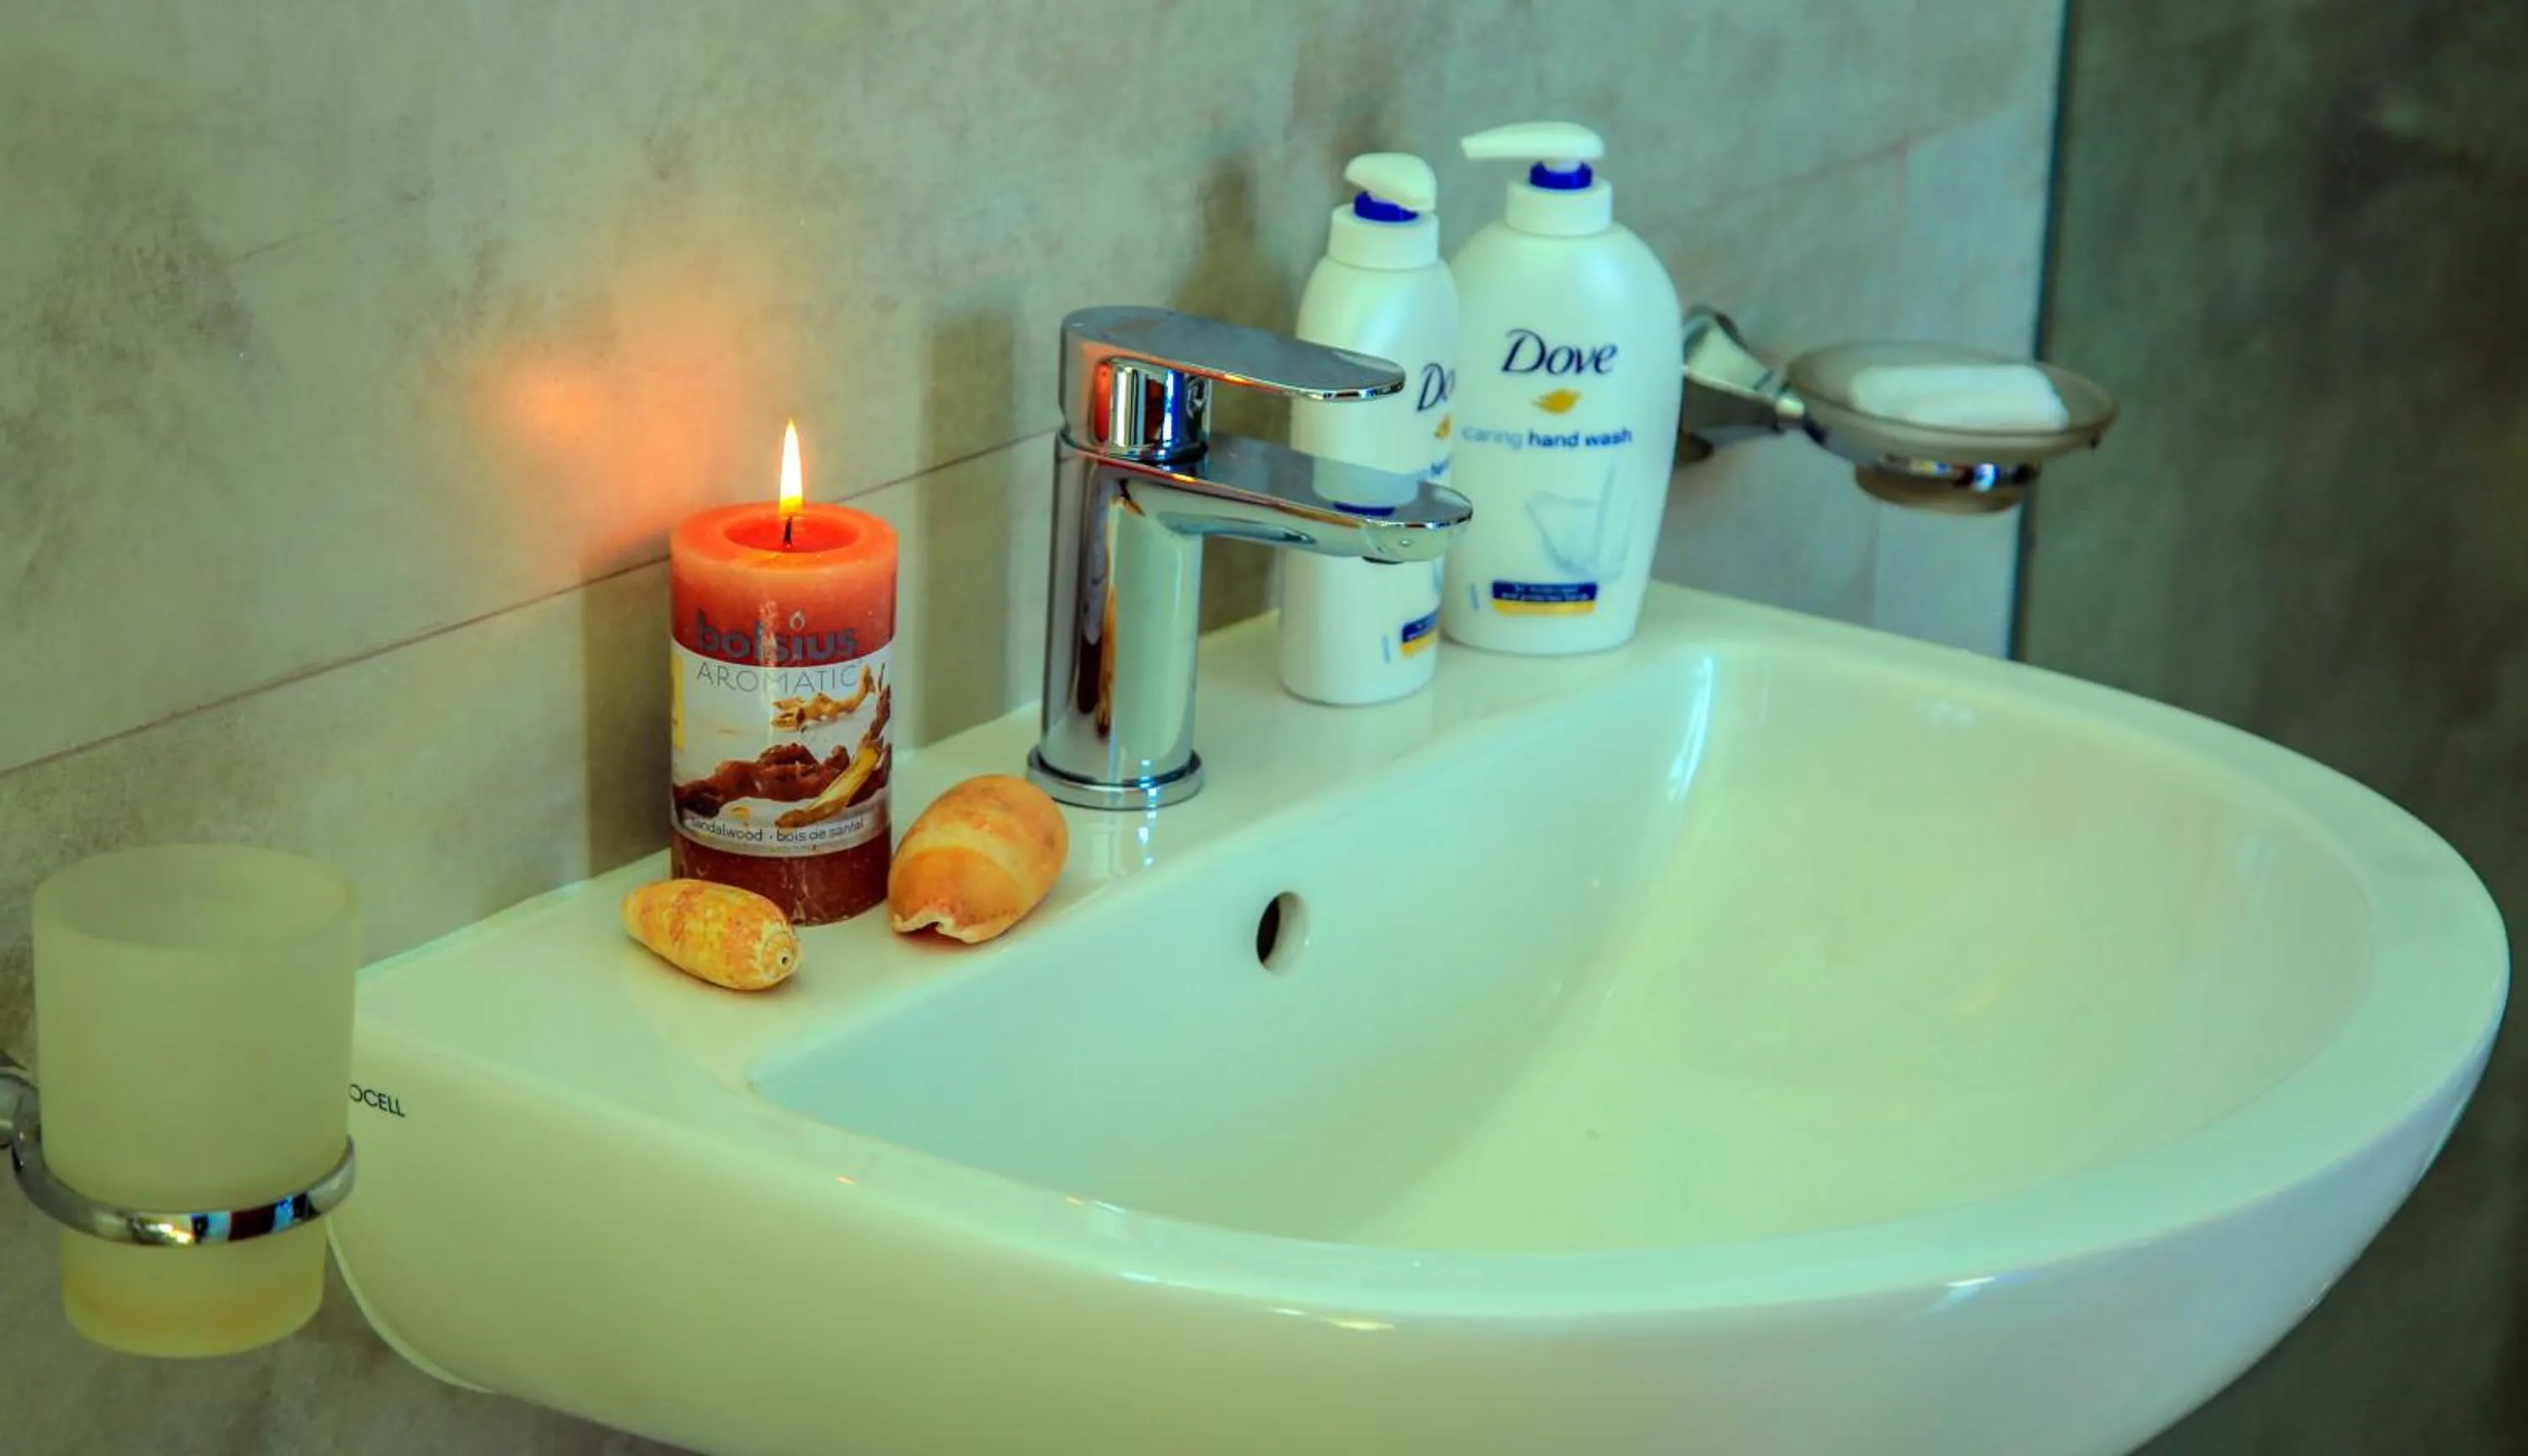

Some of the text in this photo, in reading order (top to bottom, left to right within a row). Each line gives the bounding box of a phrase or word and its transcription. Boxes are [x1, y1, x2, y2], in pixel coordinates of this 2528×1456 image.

[1500, 329, 1618, 376] Dove
[1461, 426, 1632, 450] caring hand wash
[696, 608, 857, 661] bolsius
[696, 661, 857, 693] AROMATIC
[776, 828, 806, 843] bois
[808, 827, 827, 840] de
